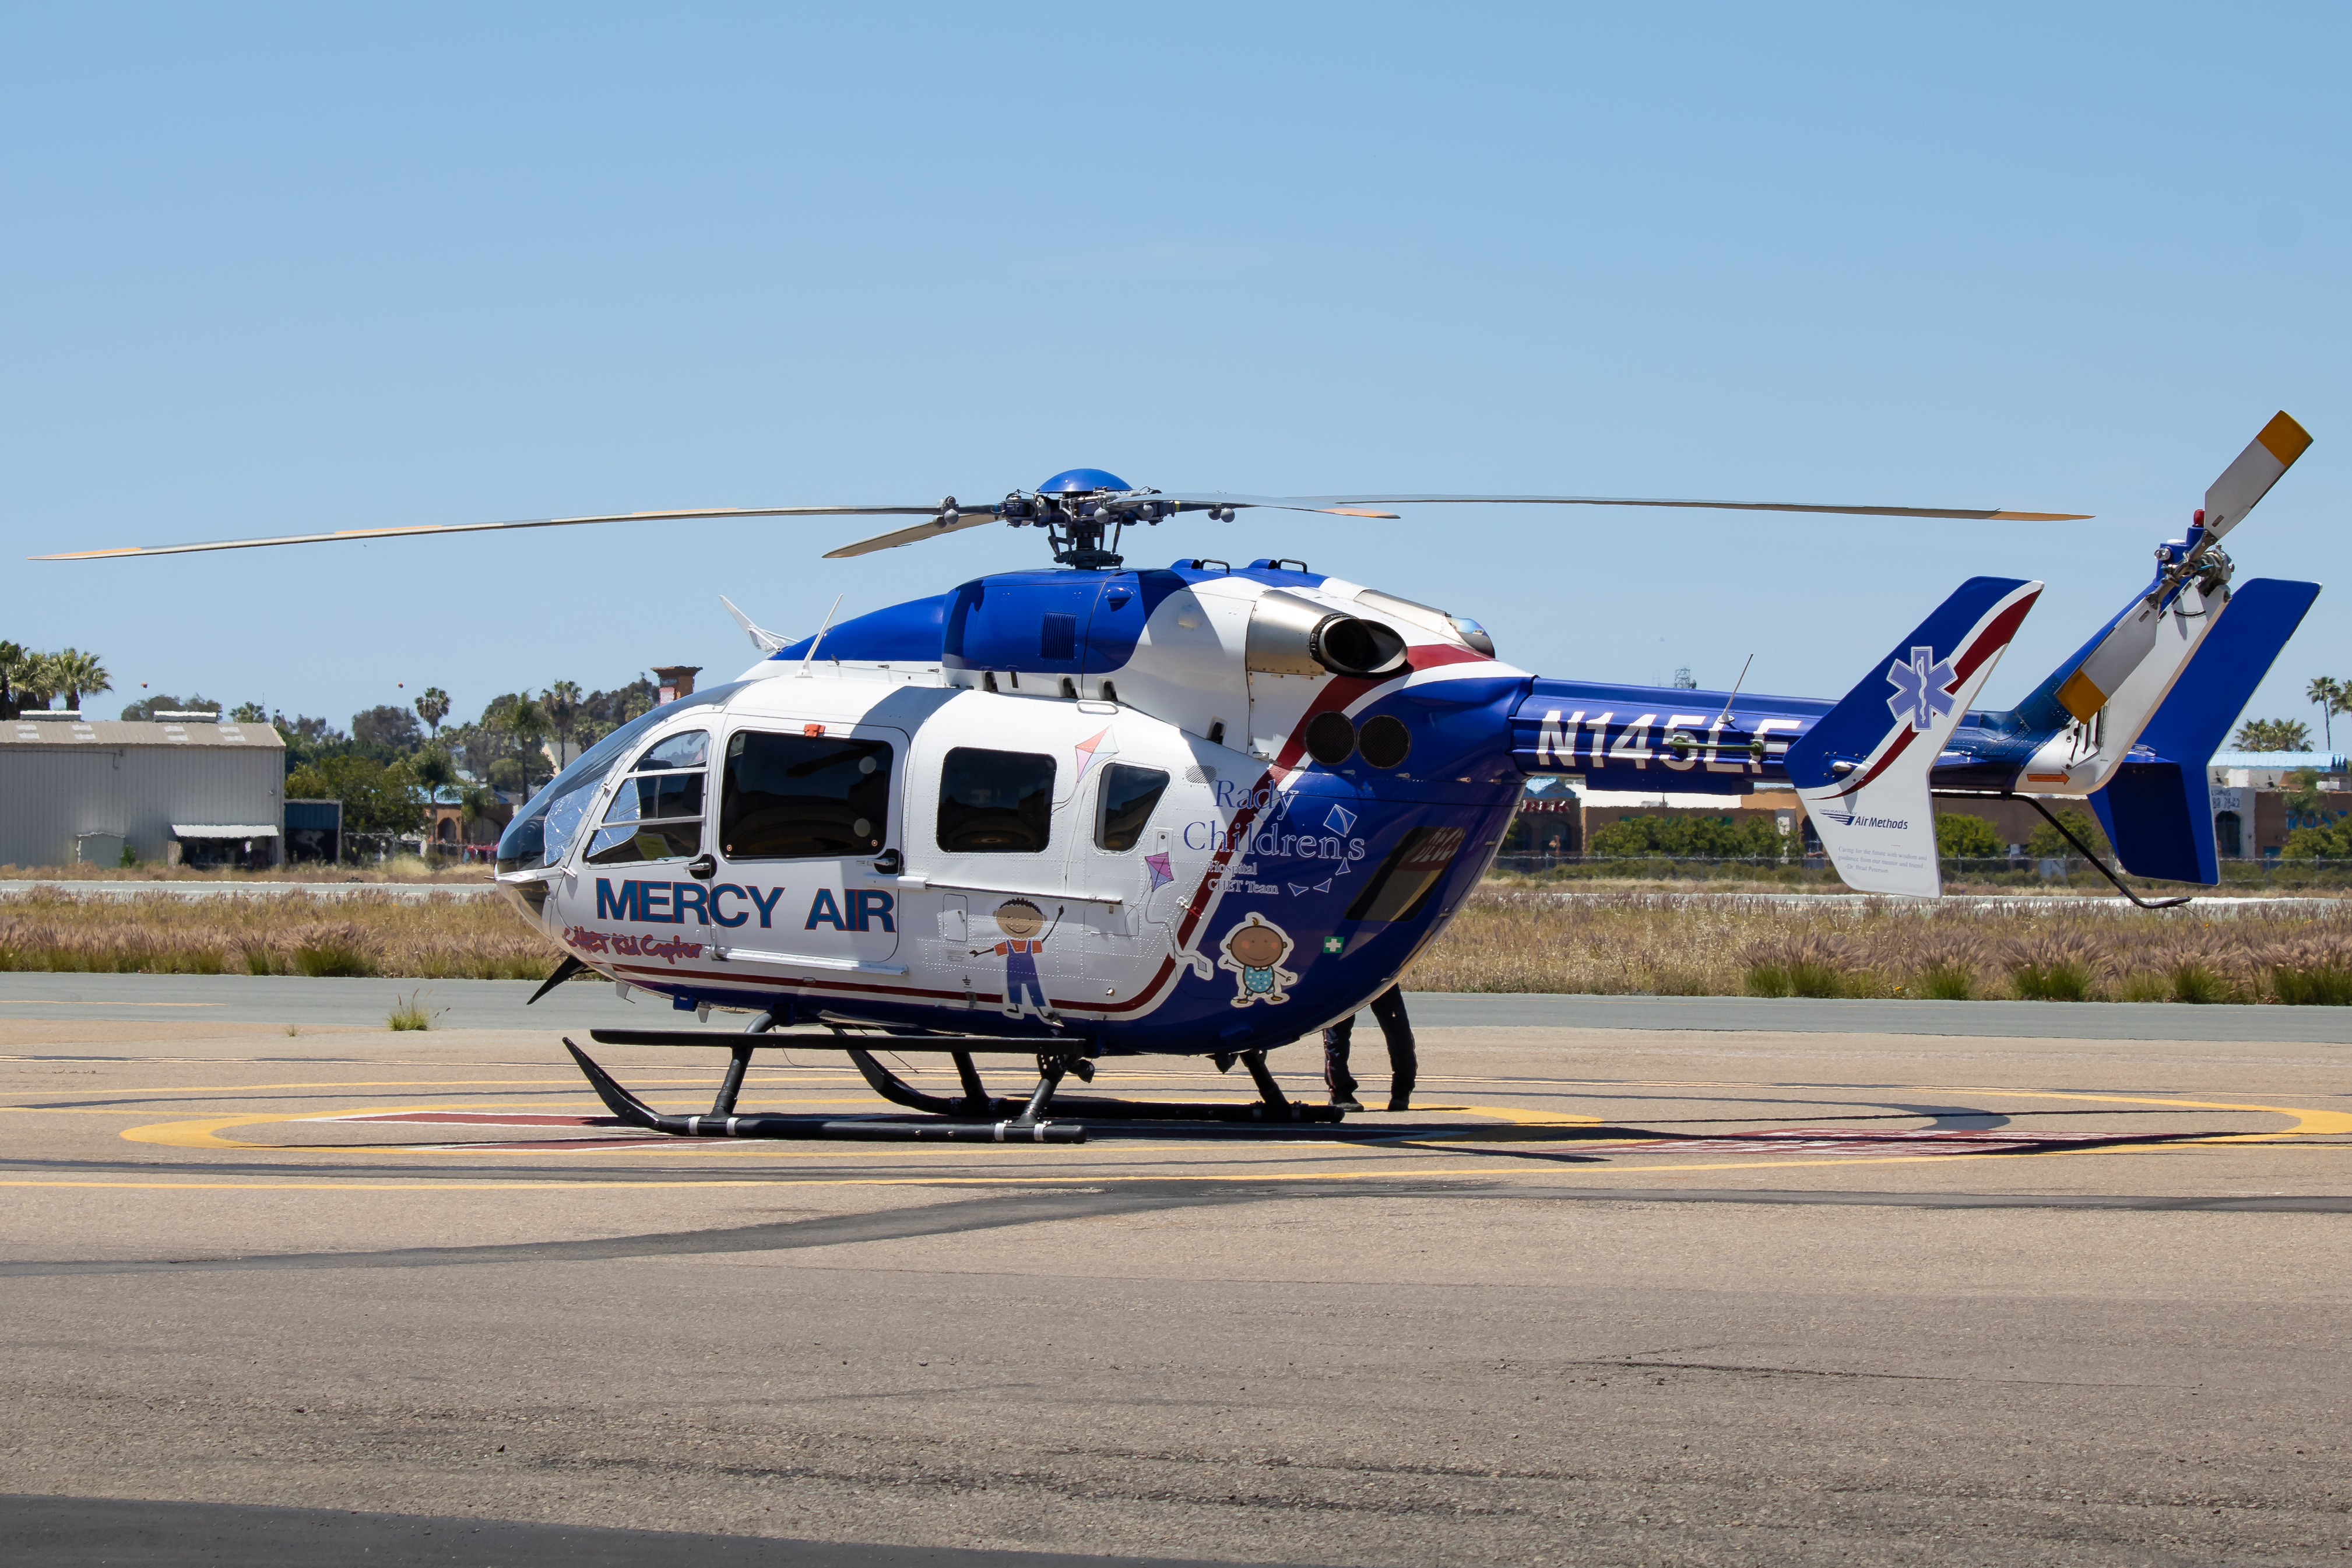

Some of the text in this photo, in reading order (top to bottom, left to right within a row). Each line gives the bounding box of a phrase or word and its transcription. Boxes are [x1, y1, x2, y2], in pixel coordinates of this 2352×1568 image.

[1536, 710, 1802, 774] N145LF
[1213, 779, 1299, 820] Rady
[1854, 816, 1908, 829] Air Methods
[1838, 846, 1854, 854] Caring
[1208, 860, 1257, 877] Hospital
[1208, 878, 1279, 895] CHET Team
[596, 878, 897, 933] MERCY AIR
[611, 933, 642, 957] Kid
[640, 934, 703, 965] Copter
